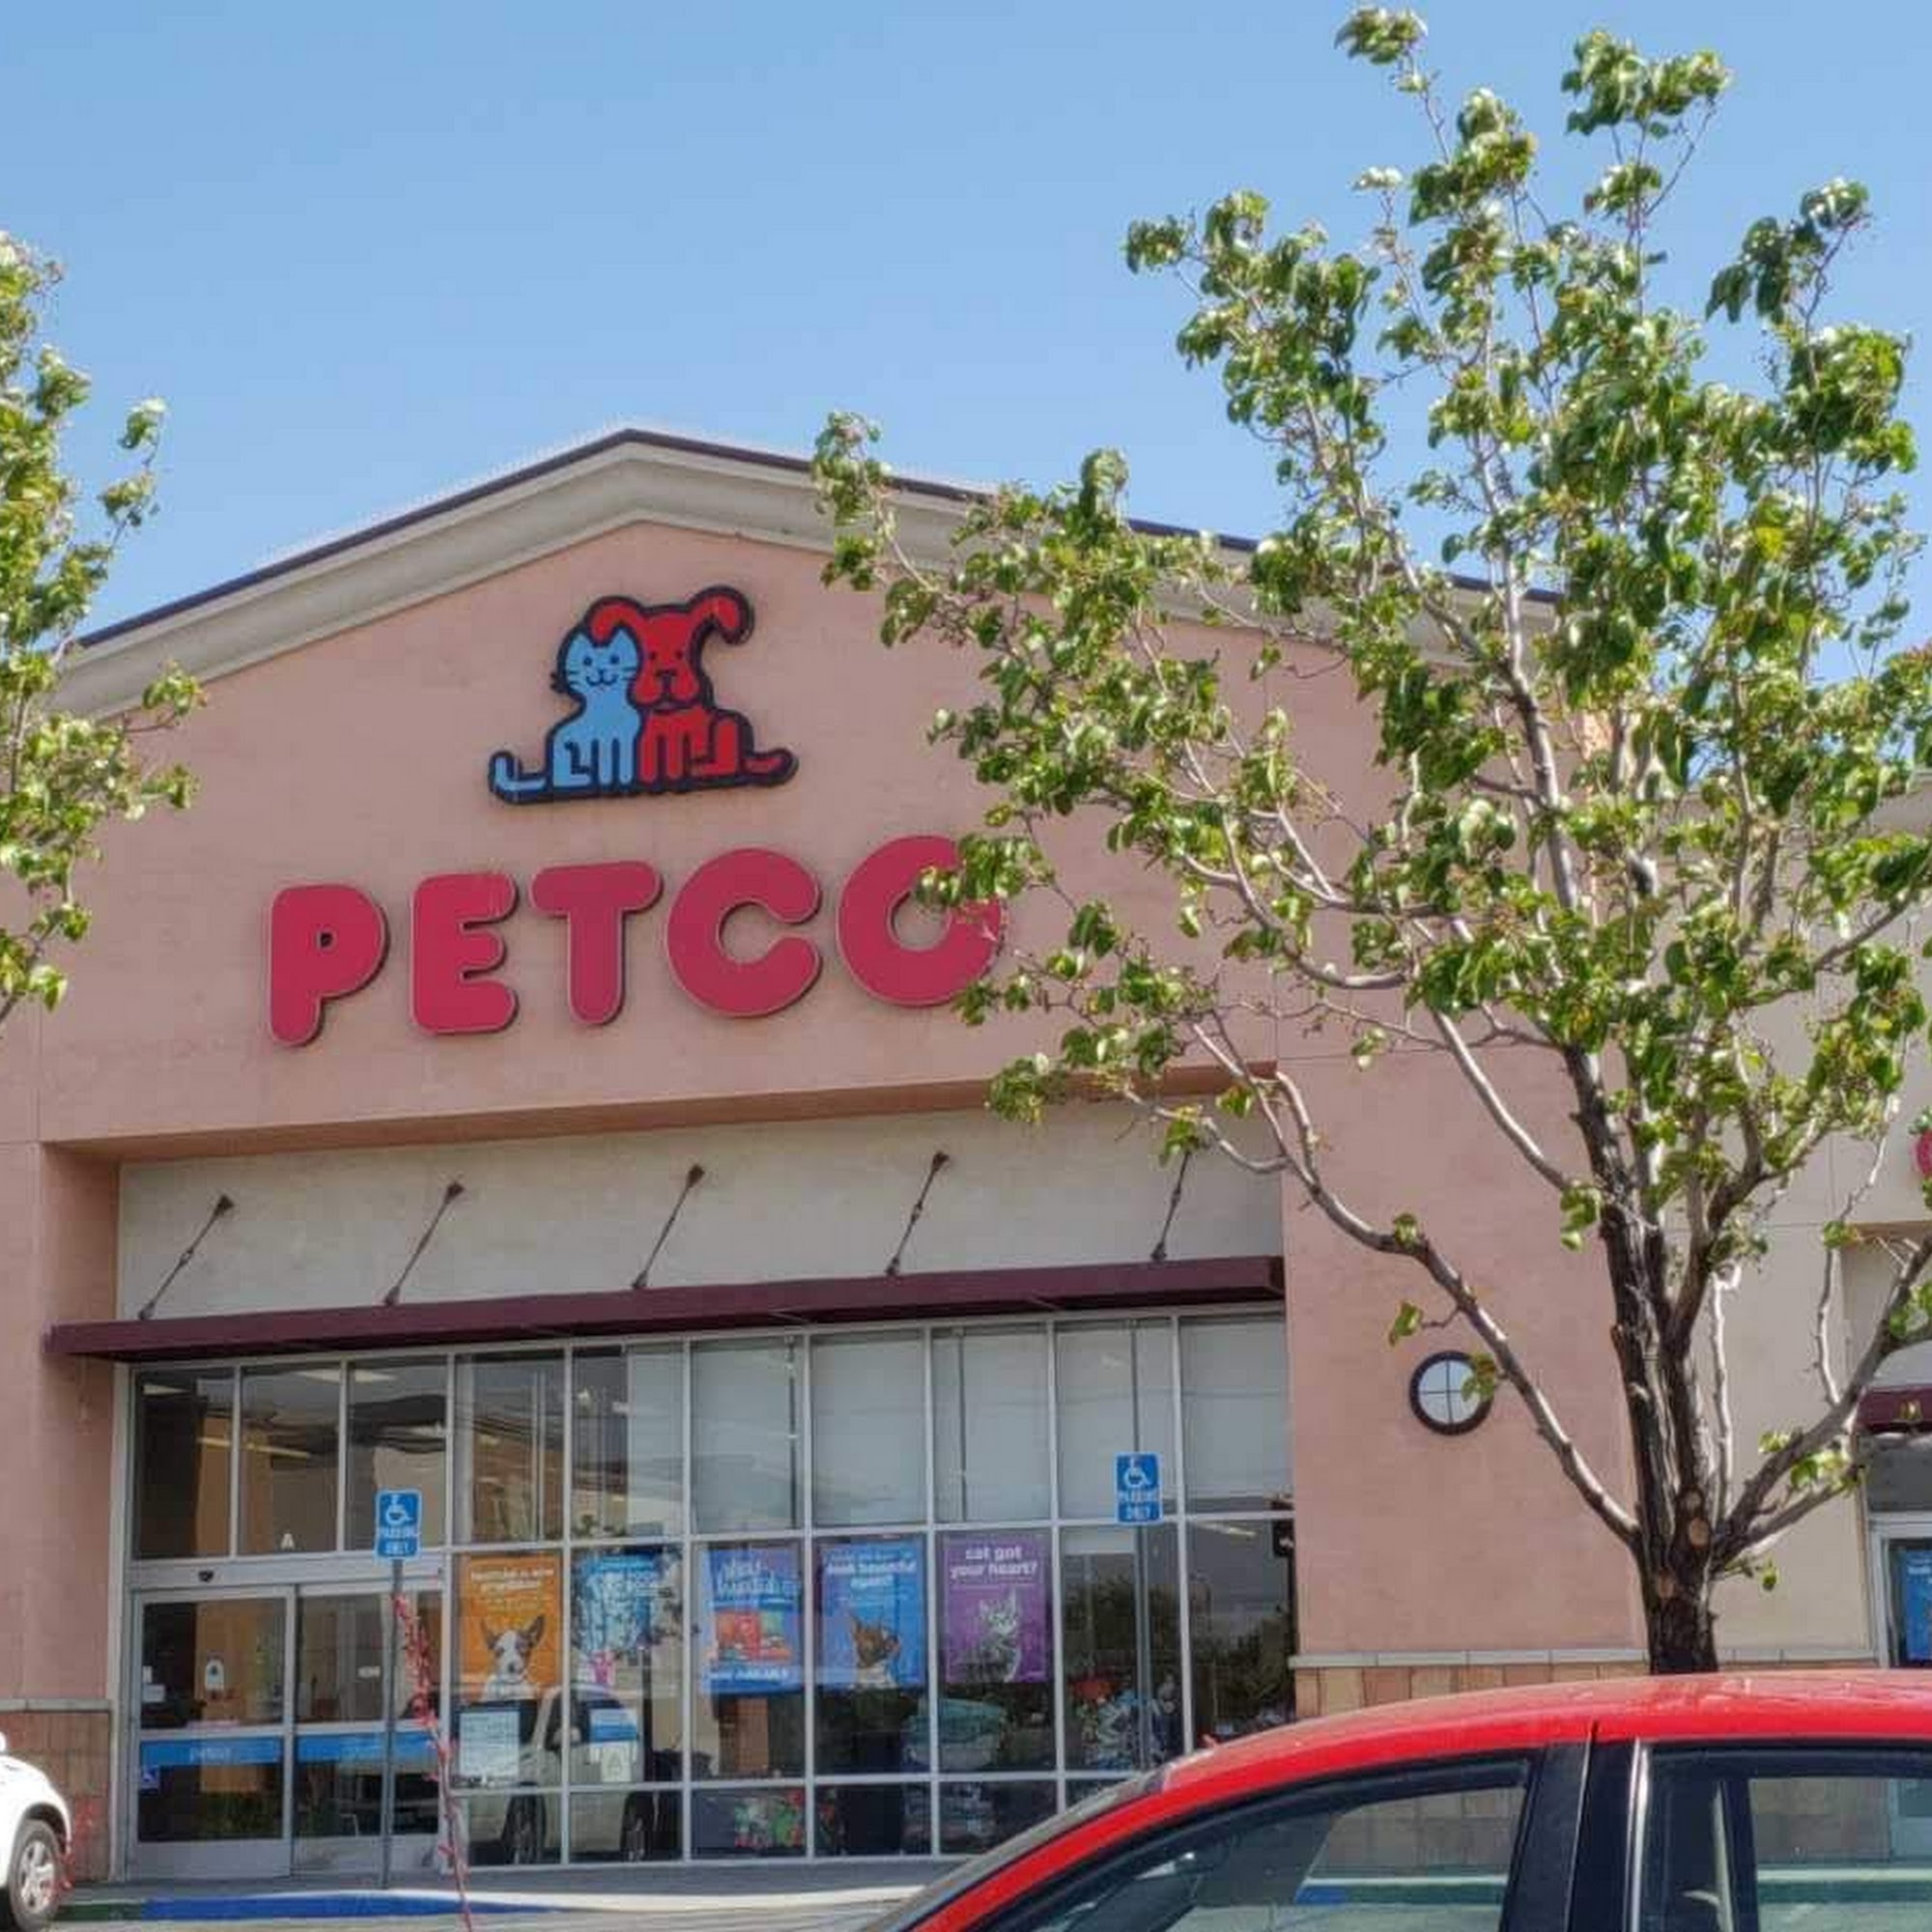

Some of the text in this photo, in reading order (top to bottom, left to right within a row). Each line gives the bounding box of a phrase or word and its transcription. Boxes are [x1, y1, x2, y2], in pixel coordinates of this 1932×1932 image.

[270, 835, 1004, 1046] PETCO
[994, 1545, 1022, 1562] got
[950, 1565, 984, 1580] your
